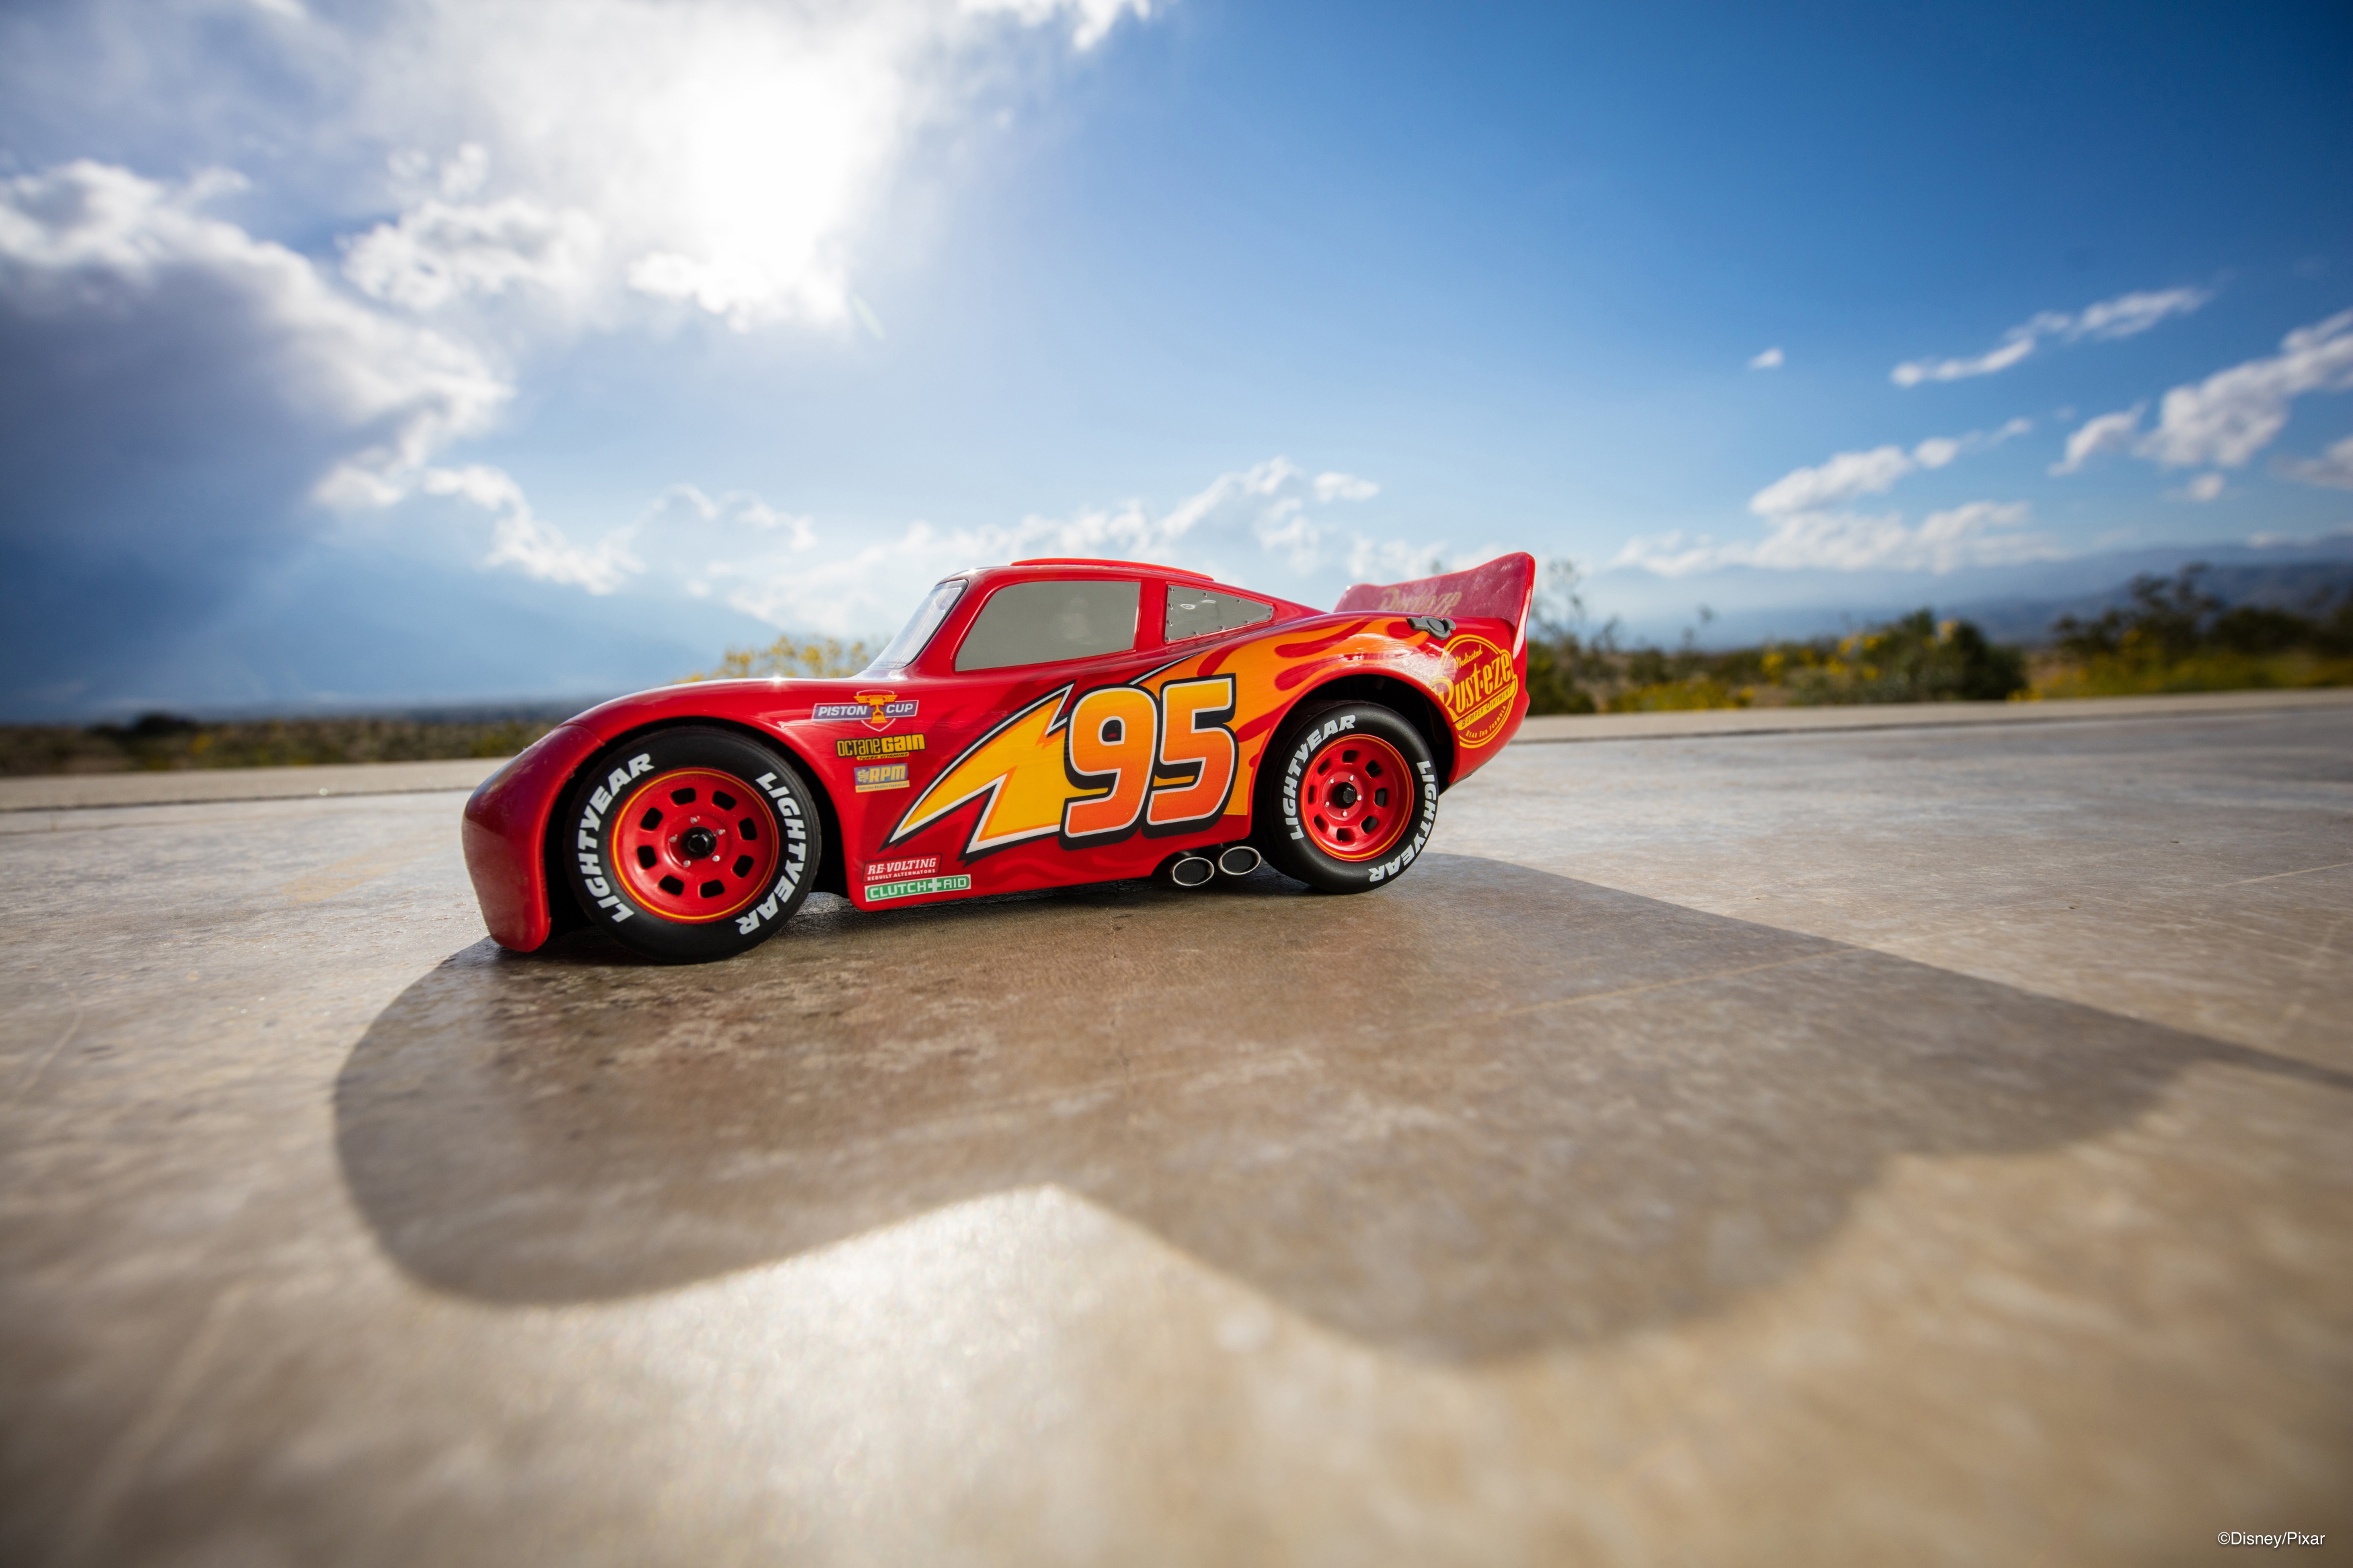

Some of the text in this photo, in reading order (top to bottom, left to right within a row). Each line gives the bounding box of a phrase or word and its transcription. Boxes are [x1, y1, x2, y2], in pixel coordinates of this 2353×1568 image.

[1451, 645, 1482, 671] Medicated
[817, 703, 913, 716] PISTON CUP
[1462, 688, 1511, 727] BUMPER OINTMENT
[1466, 706, 1507, 739] REAR END FORMULA
[869, 765, 906, 783] RPM
[1065, 677, 1235, 837] 95
[1283, 715, 1356, 839] LIGHTYEAR
[577, 753, 655, 923] LIGHTYEAR
[1368, 761, 1437, 882] LIGHTYEAR
[735, 772, 807, 935] LIGHTYEAR
[869, 877, 967, 898] CLUTCH AID
[893, 868, 936, 878] ALTERNATORS
